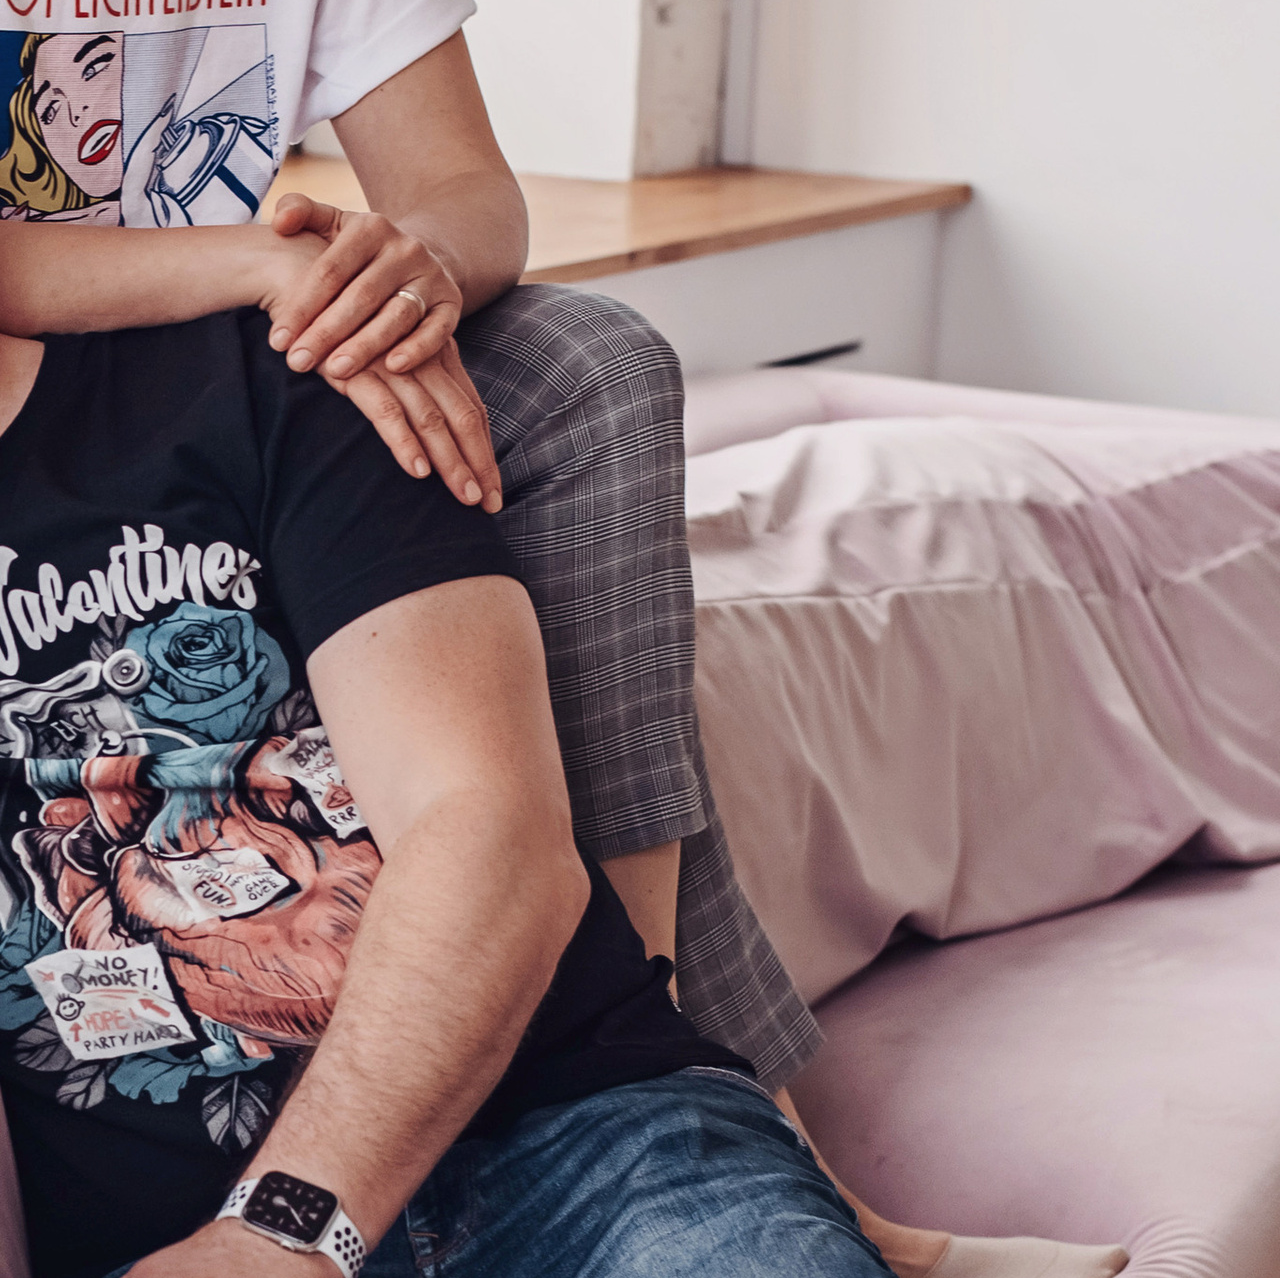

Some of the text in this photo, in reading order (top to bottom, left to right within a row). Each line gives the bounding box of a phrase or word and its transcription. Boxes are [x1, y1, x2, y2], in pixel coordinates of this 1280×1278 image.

[94, 956, 127, 972] NO
[84, 1024, 181, 1052] PARTY HARD
